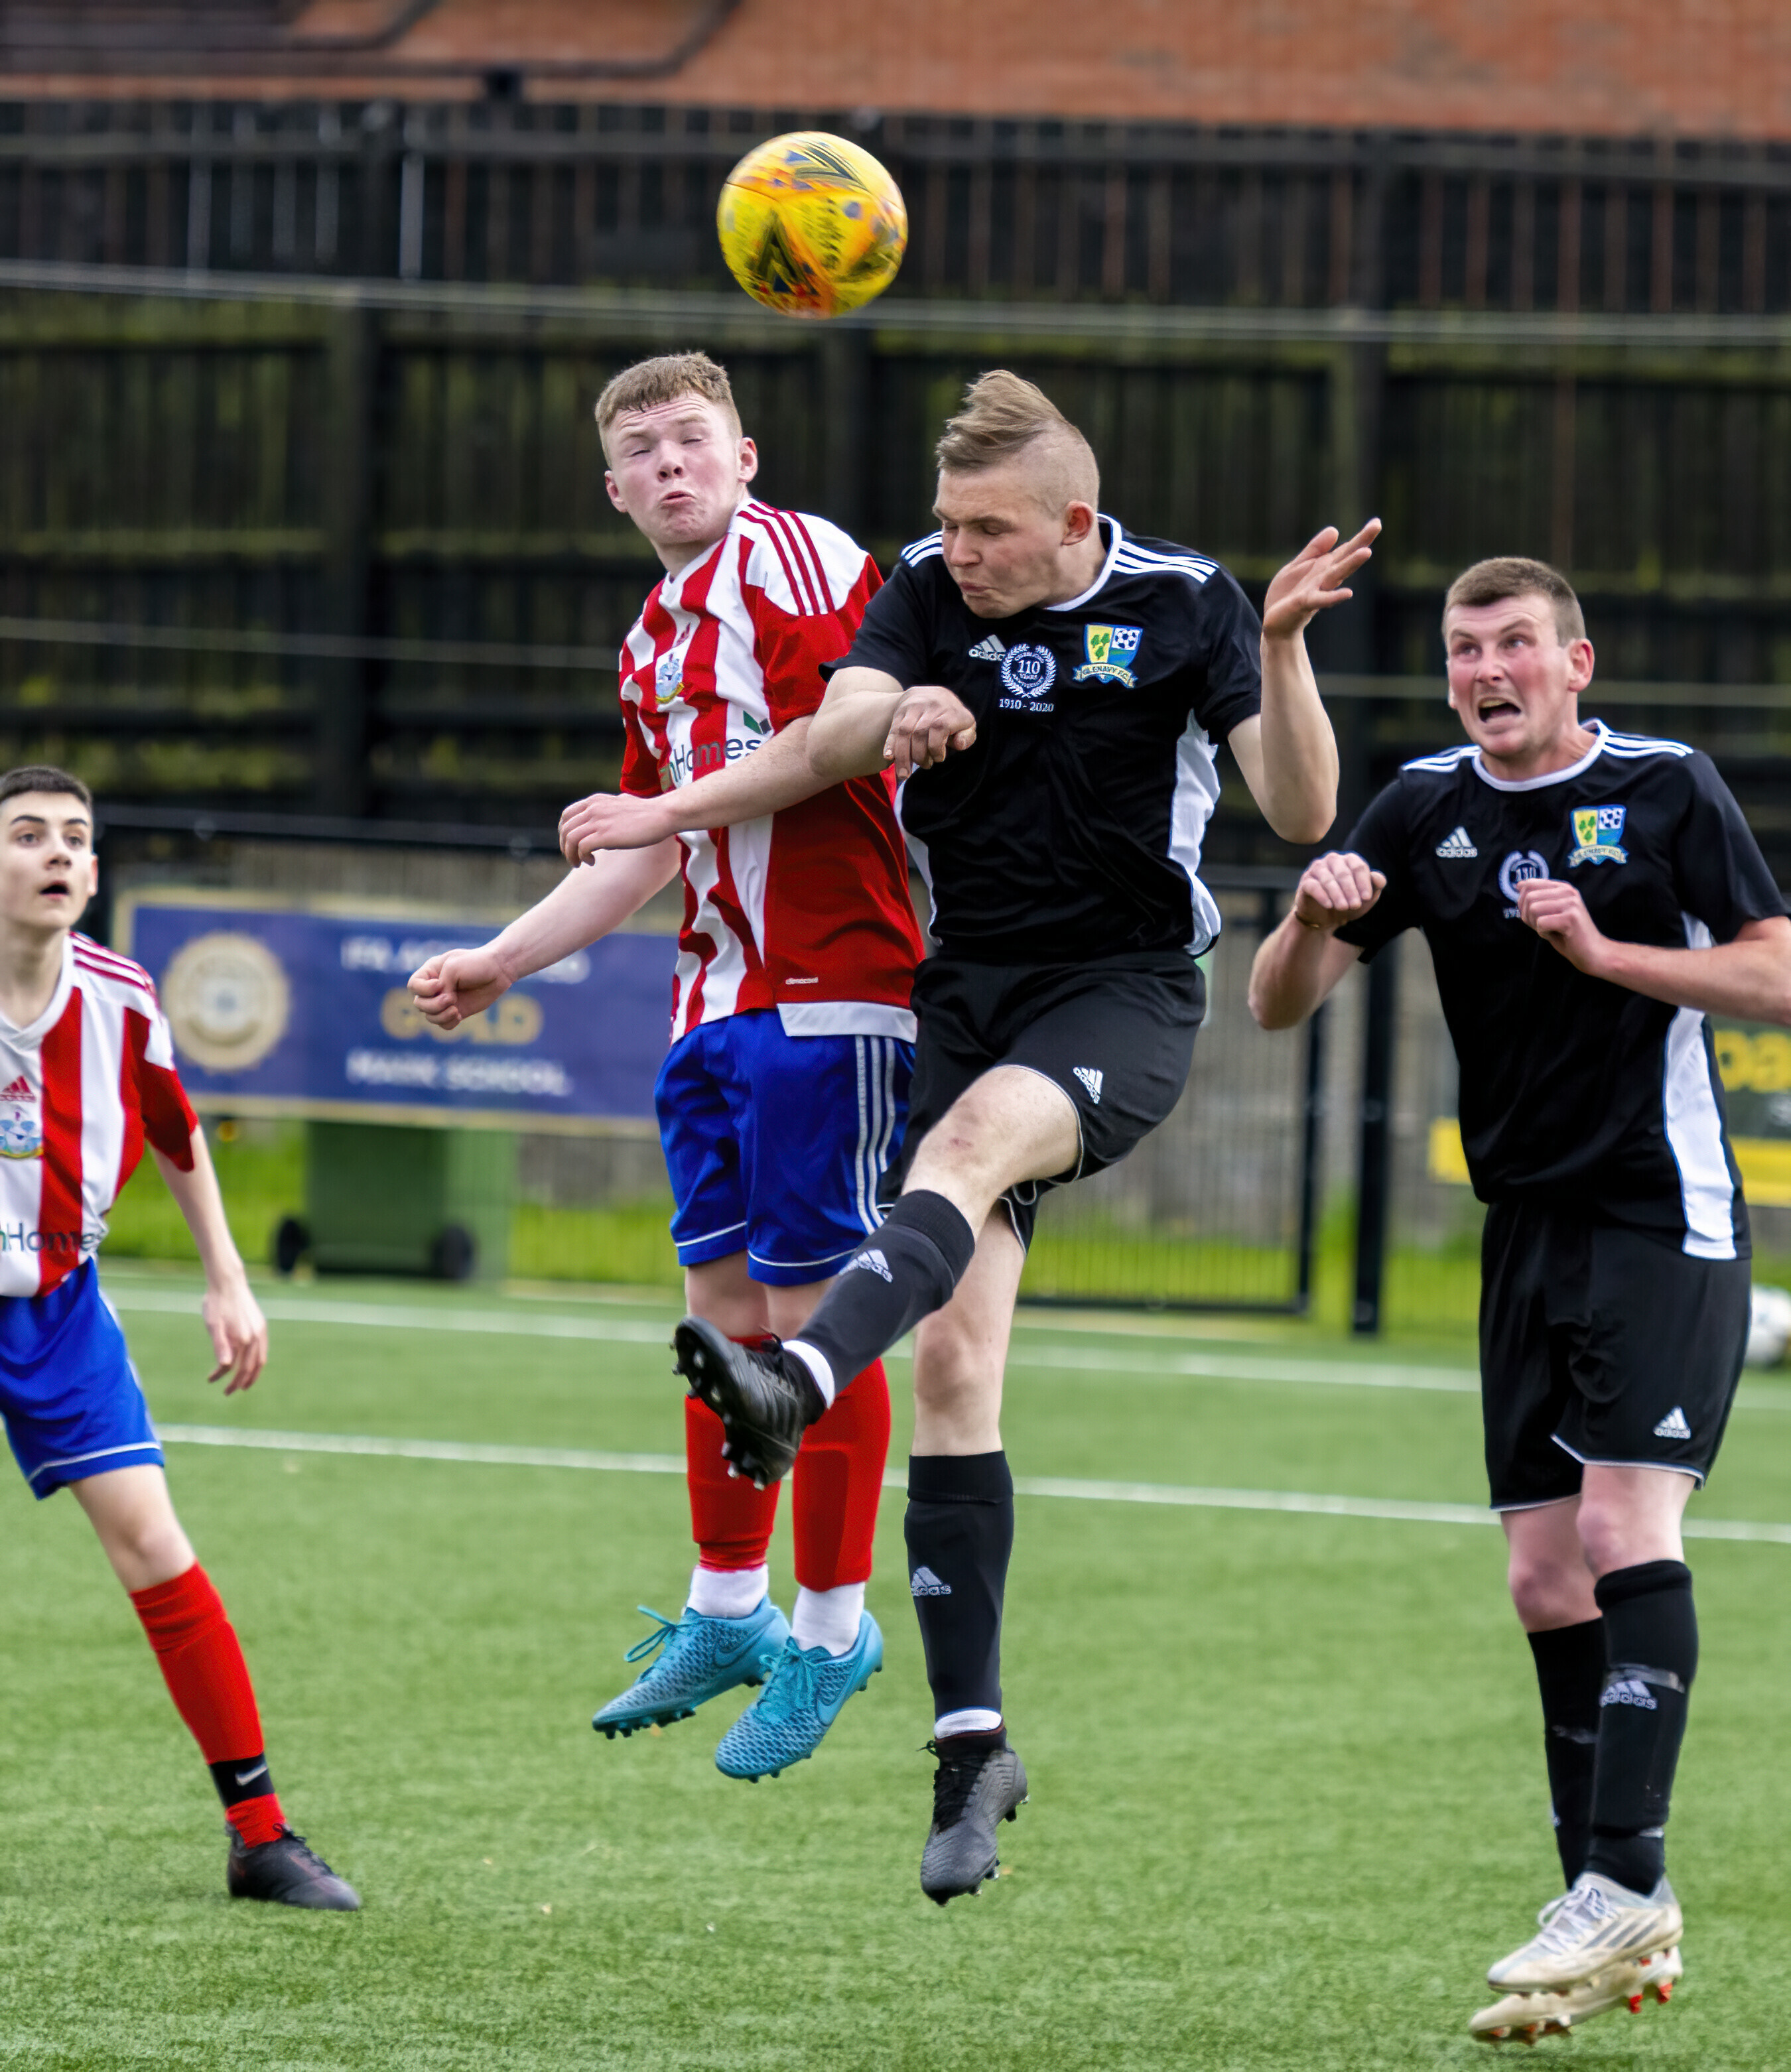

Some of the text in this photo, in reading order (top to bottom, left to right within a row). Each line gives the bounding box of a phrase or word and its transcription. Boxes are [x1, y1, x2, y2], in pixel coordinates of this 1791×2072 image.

[1018, 660, 1041, 675] 110
[999, 698, 1022, 710] 1910
[1029, 701, 1055, 712] 2020
[1436, 847, 1478, 858] adidas
